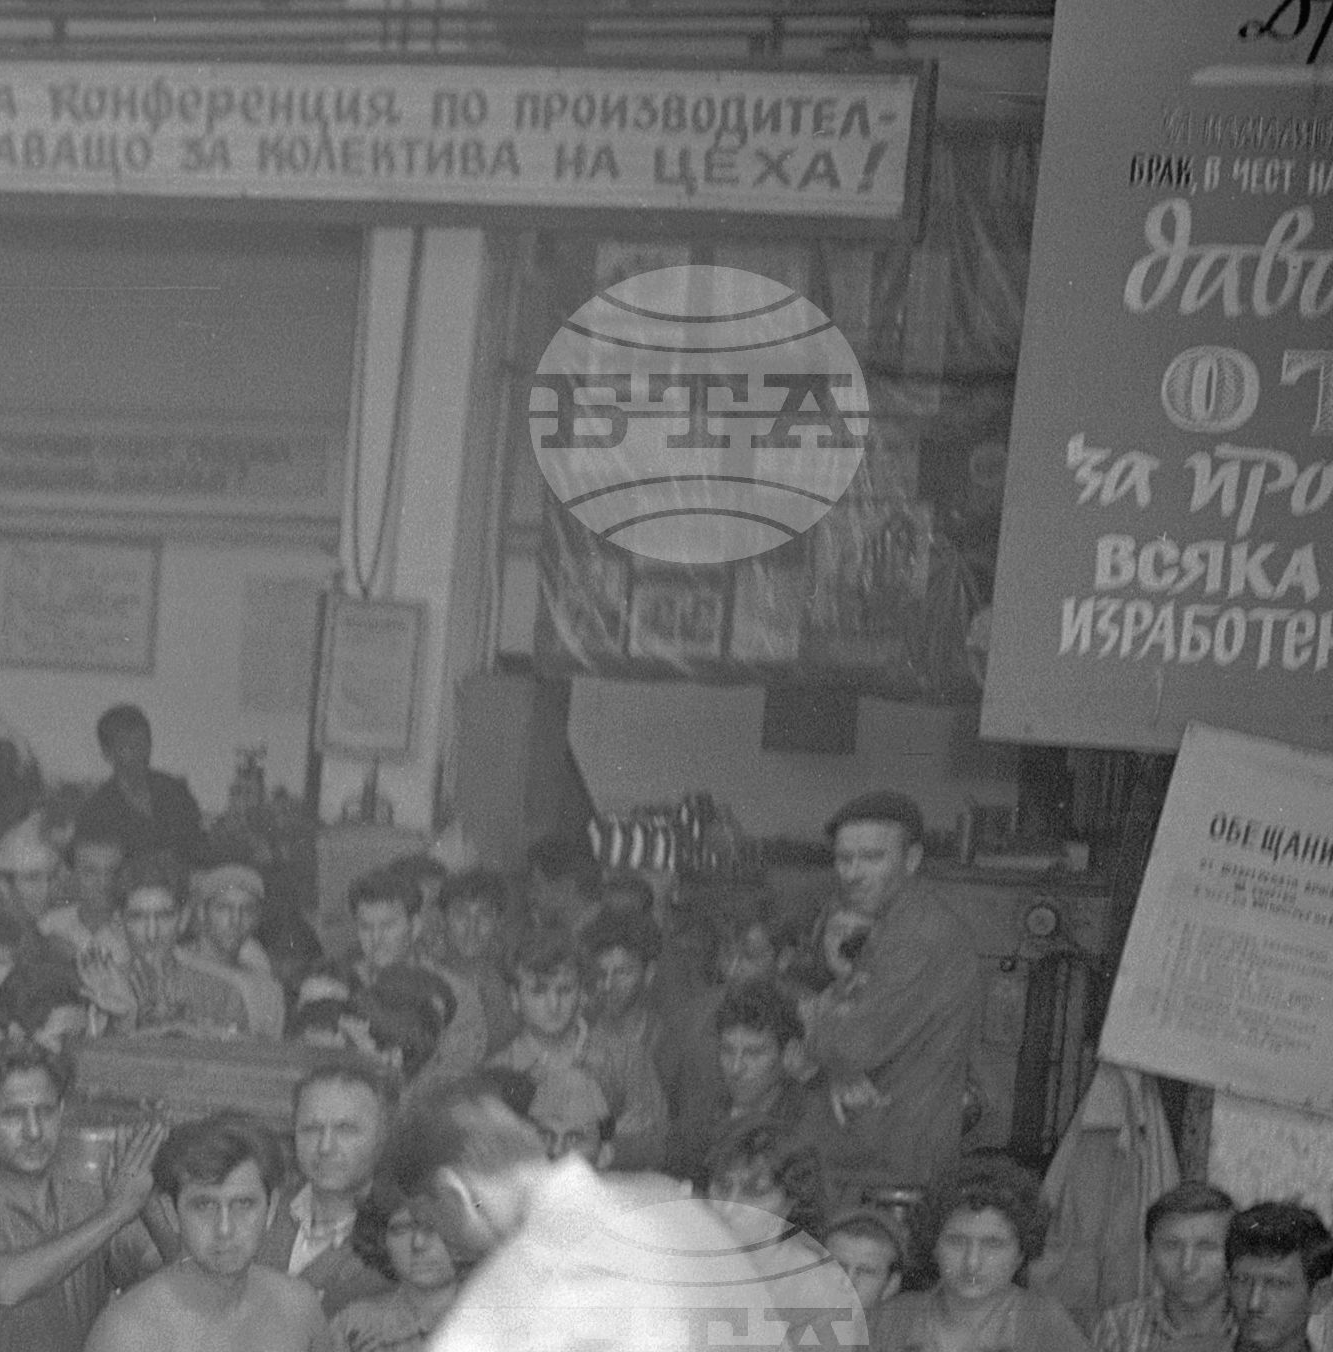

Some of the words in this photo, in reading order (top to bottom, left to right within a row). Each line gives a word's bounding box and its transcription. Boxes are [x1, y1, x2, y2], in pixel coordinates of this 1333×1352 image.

[434, 86, 488, 129] ПО
[516, 88, 898, 147] ПРОИЗВОДИТЕЛ-
[183, 135, 232, 172] ЗА
[256, 134, 521, 178] КОЛЕКТИВА
[554, 142, 620, 182] НА
[653, 142, 890, 196] ЦЕХА!
[1232, 157, 1294, 195] ЧЕСТ
[1094, 533, 1321, 604] ВСЯКА
